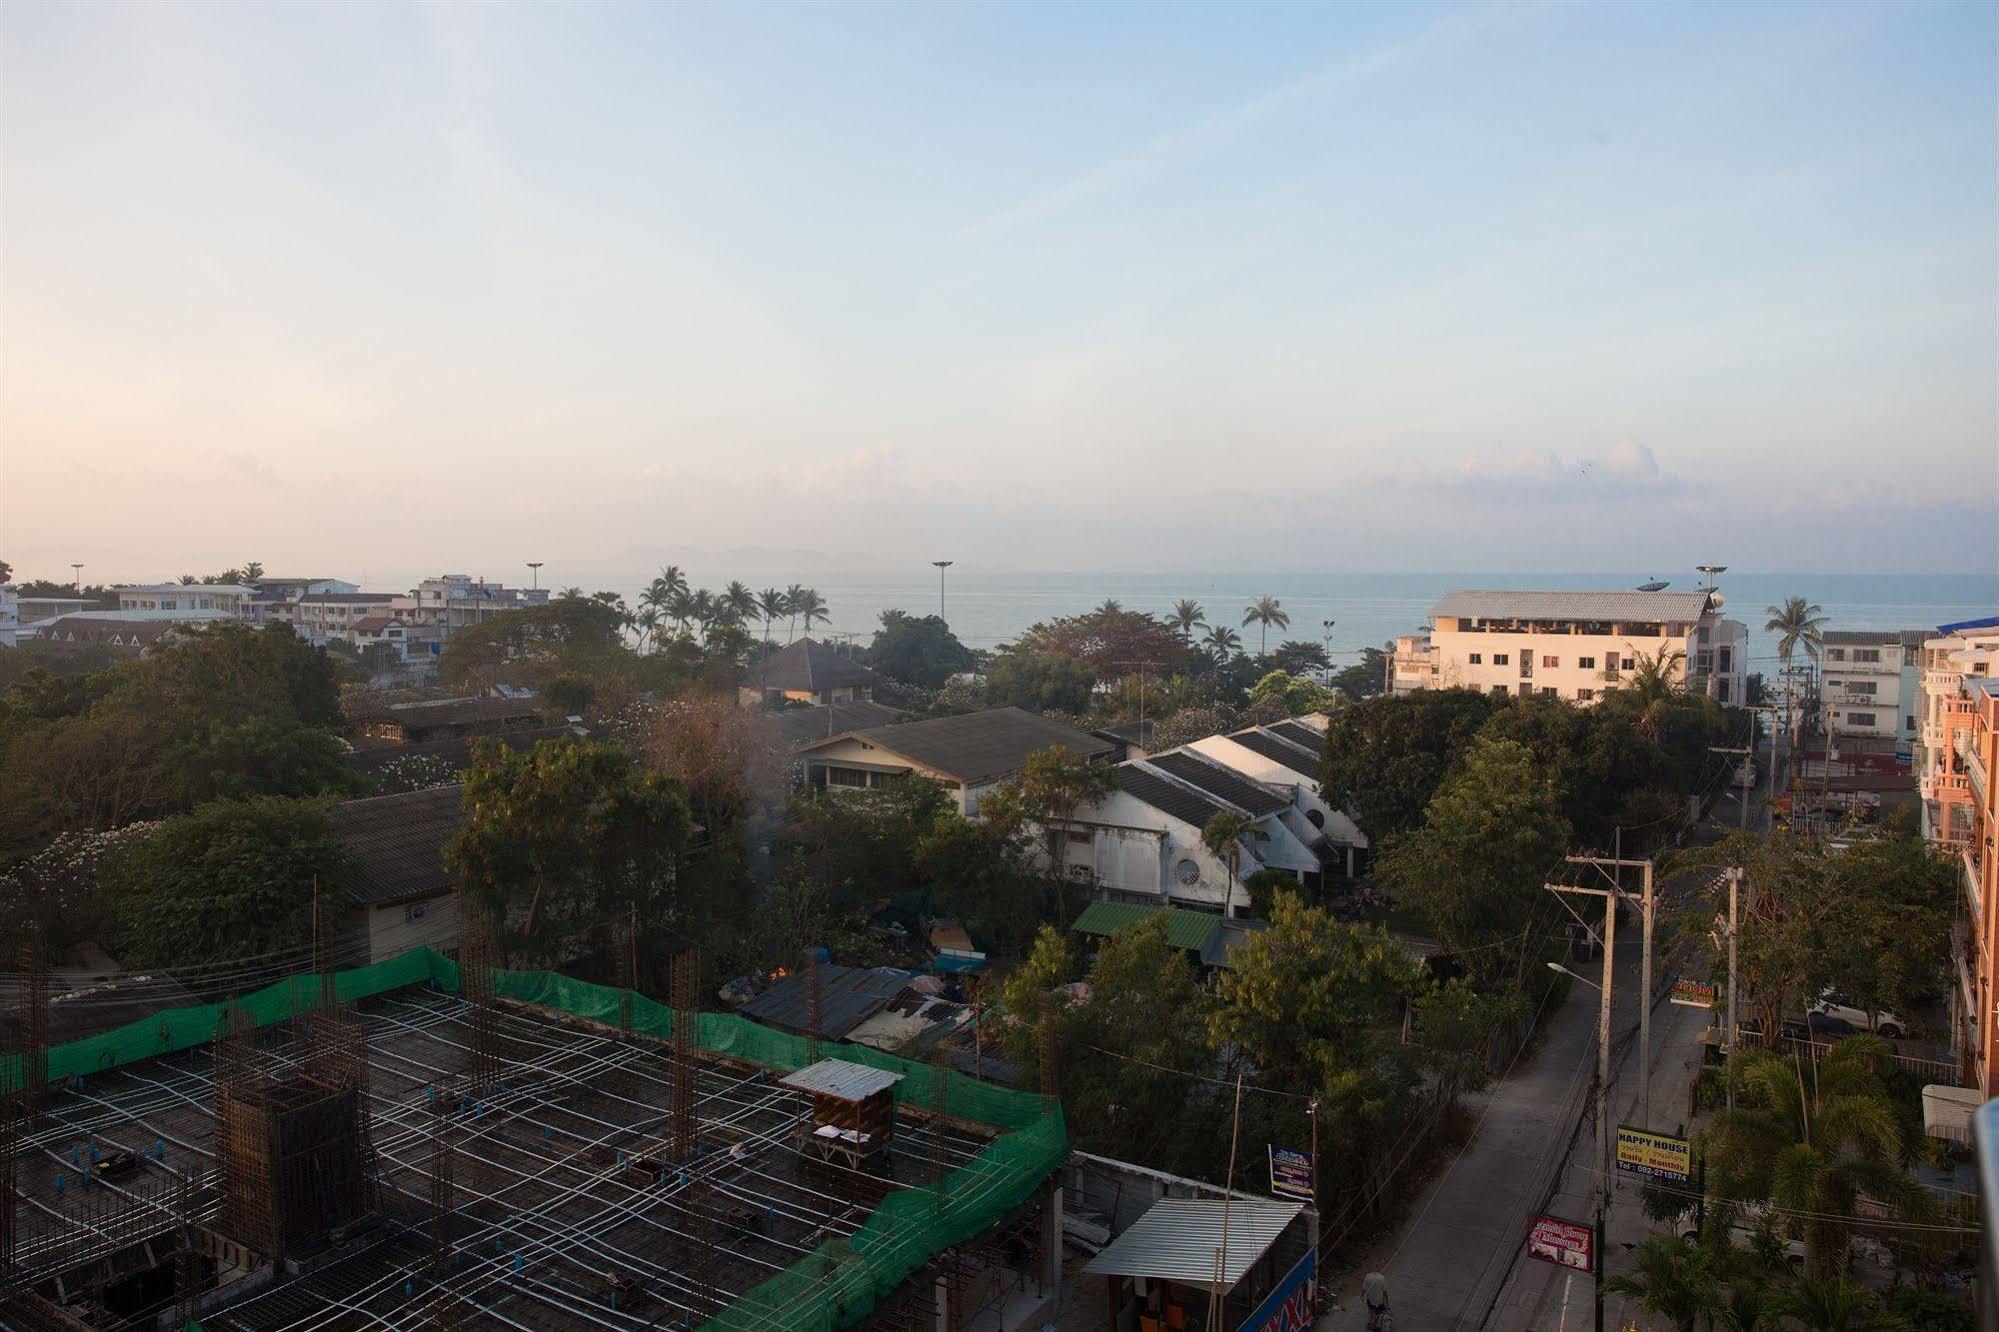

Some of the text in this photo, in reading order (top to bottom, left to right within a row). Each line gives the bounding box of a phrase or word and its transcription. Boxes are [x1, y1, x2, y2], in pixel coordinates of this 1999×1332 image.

[1619, 1133, 1688, 1154] HAPPY HOUSE
[1621, 1152, 1643, 1163] Daily
[1648, 1157, 1685, 1171] Monthly
